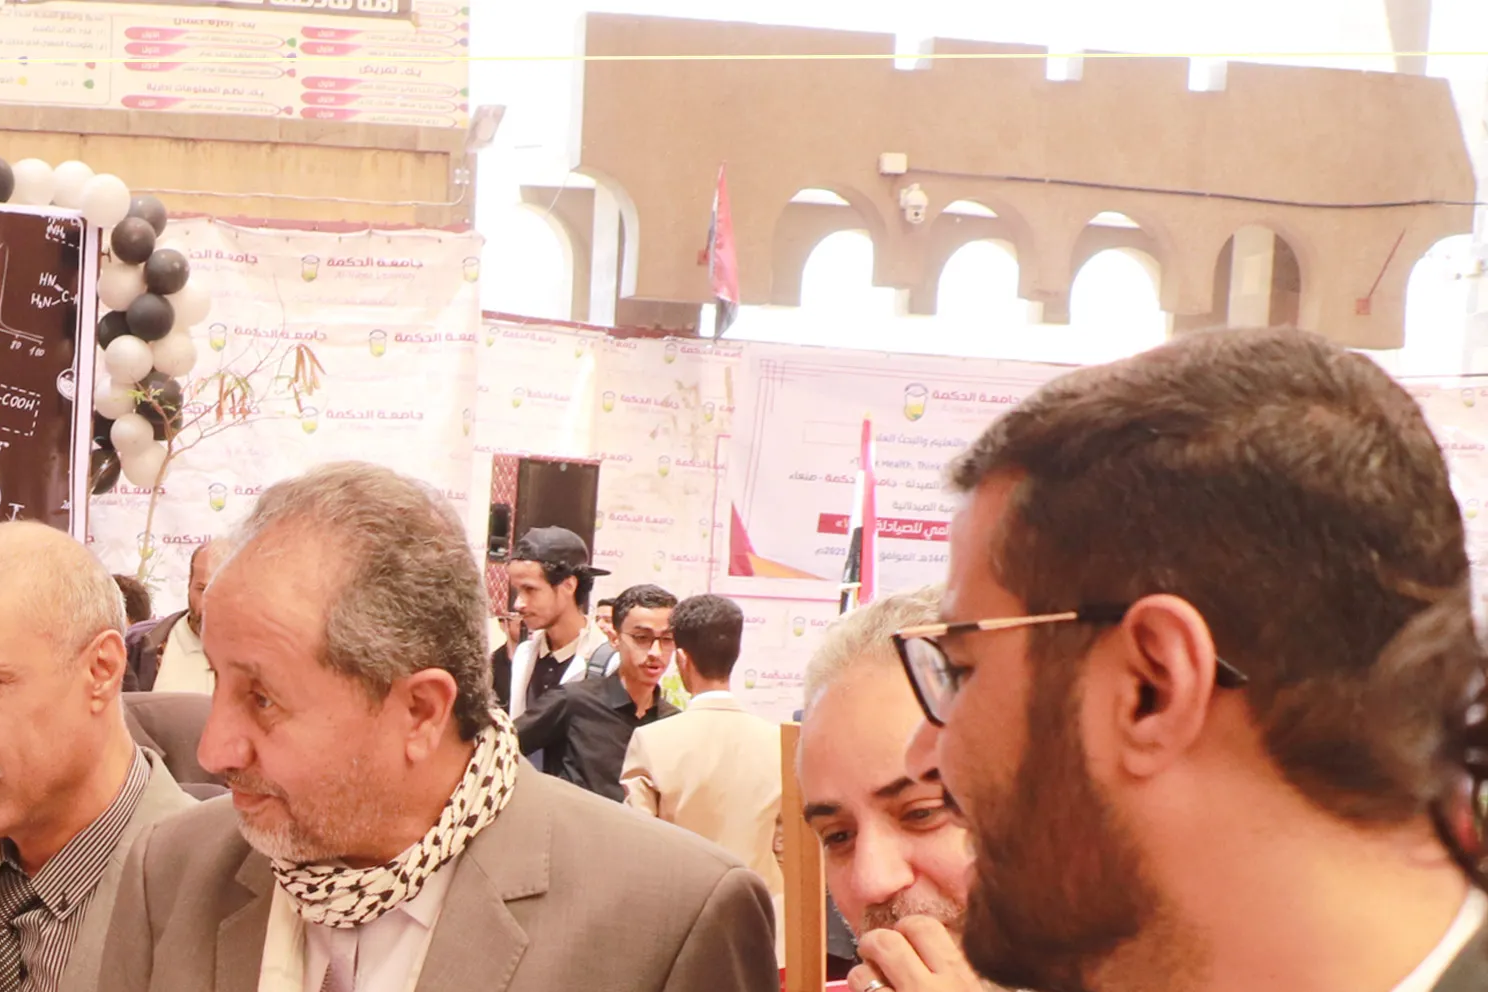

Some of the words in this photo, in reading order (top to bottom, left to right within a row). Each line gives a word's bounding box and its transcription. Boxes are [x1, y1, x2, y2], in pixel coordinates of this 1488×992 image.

[326, 256, 374, 268] الحكمة
[39, 272, 57, 287] HN
[931, 388, 977, 403] الحكمة
[325, 408, 374, 420] الحكمة
